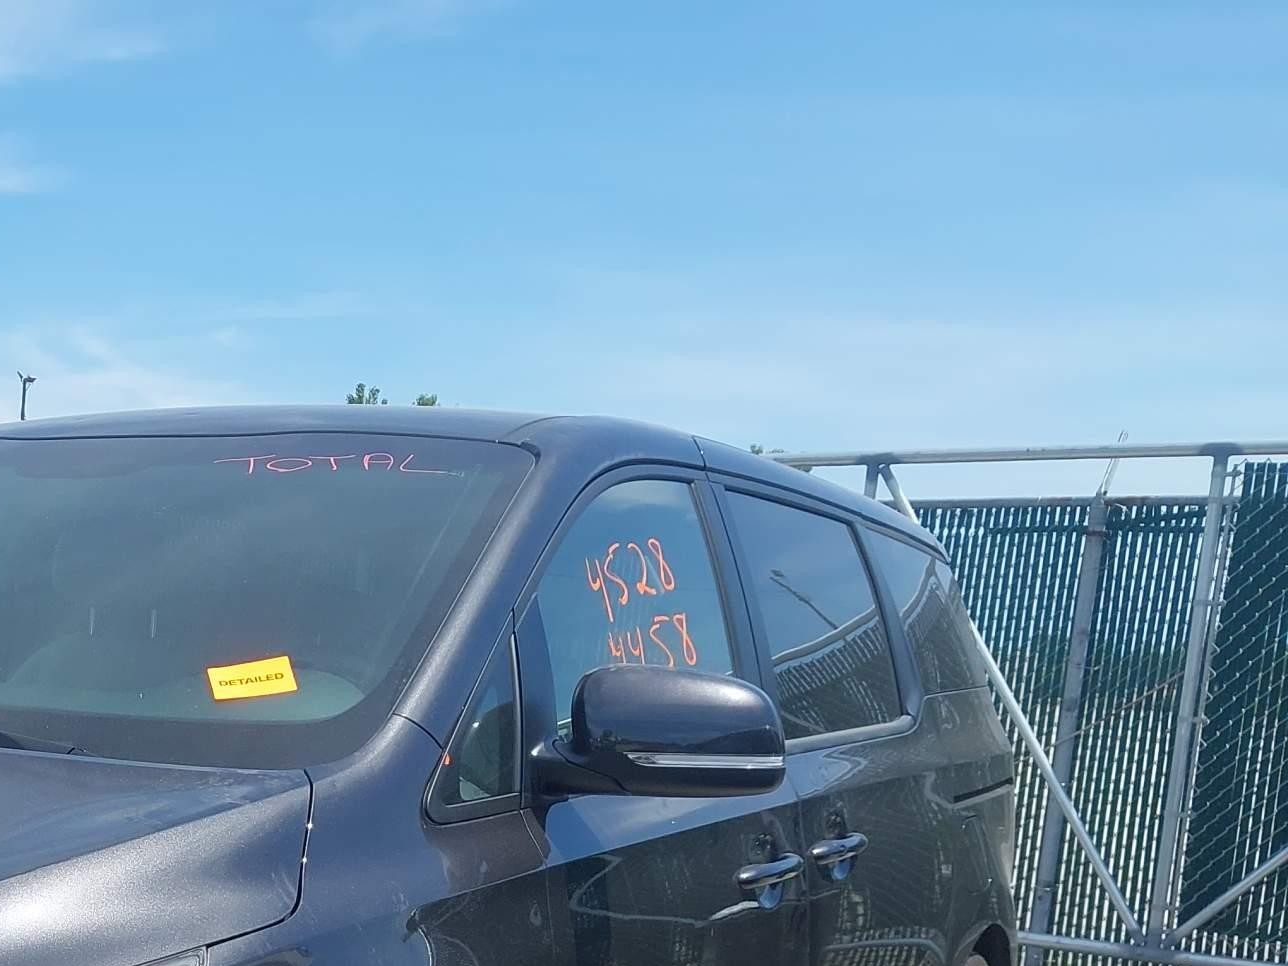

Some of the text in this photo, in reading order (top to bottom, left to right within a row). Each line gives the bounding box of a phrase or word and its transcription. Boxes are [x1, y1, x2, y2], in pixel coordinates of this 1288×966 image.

[213, 453, 463, 475] TOTAL
[585, 538, 675, 622] 4528
[608, 612, 697, 668] 4458
[218, 672, 285, 687] DETAILED
